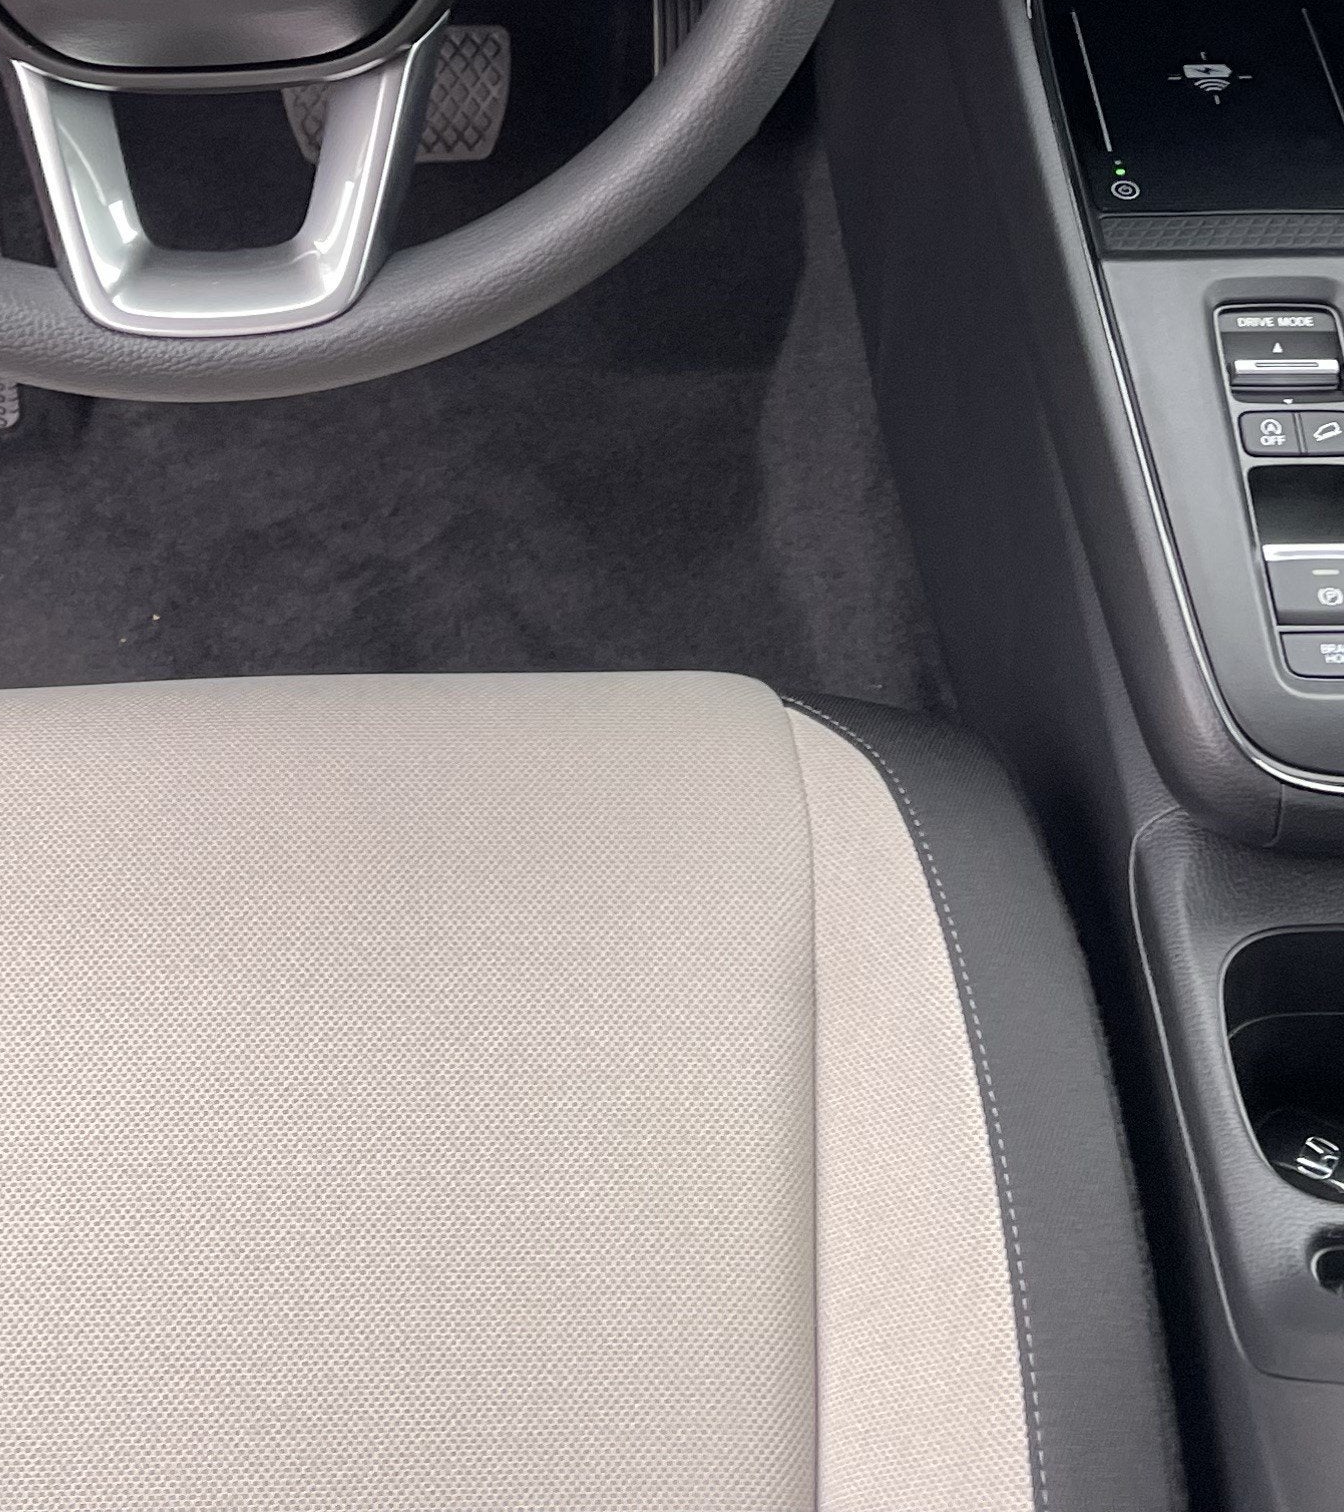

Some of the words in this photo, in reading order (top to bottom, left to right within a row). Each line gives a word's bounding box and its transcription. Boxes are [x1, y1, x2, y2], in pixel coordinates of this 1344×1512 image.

[1237, 316, 1275, 327] DRIVE
[1277, 316, 1314, 327] MODE
[1260, 434, 1286, 446] OFF
